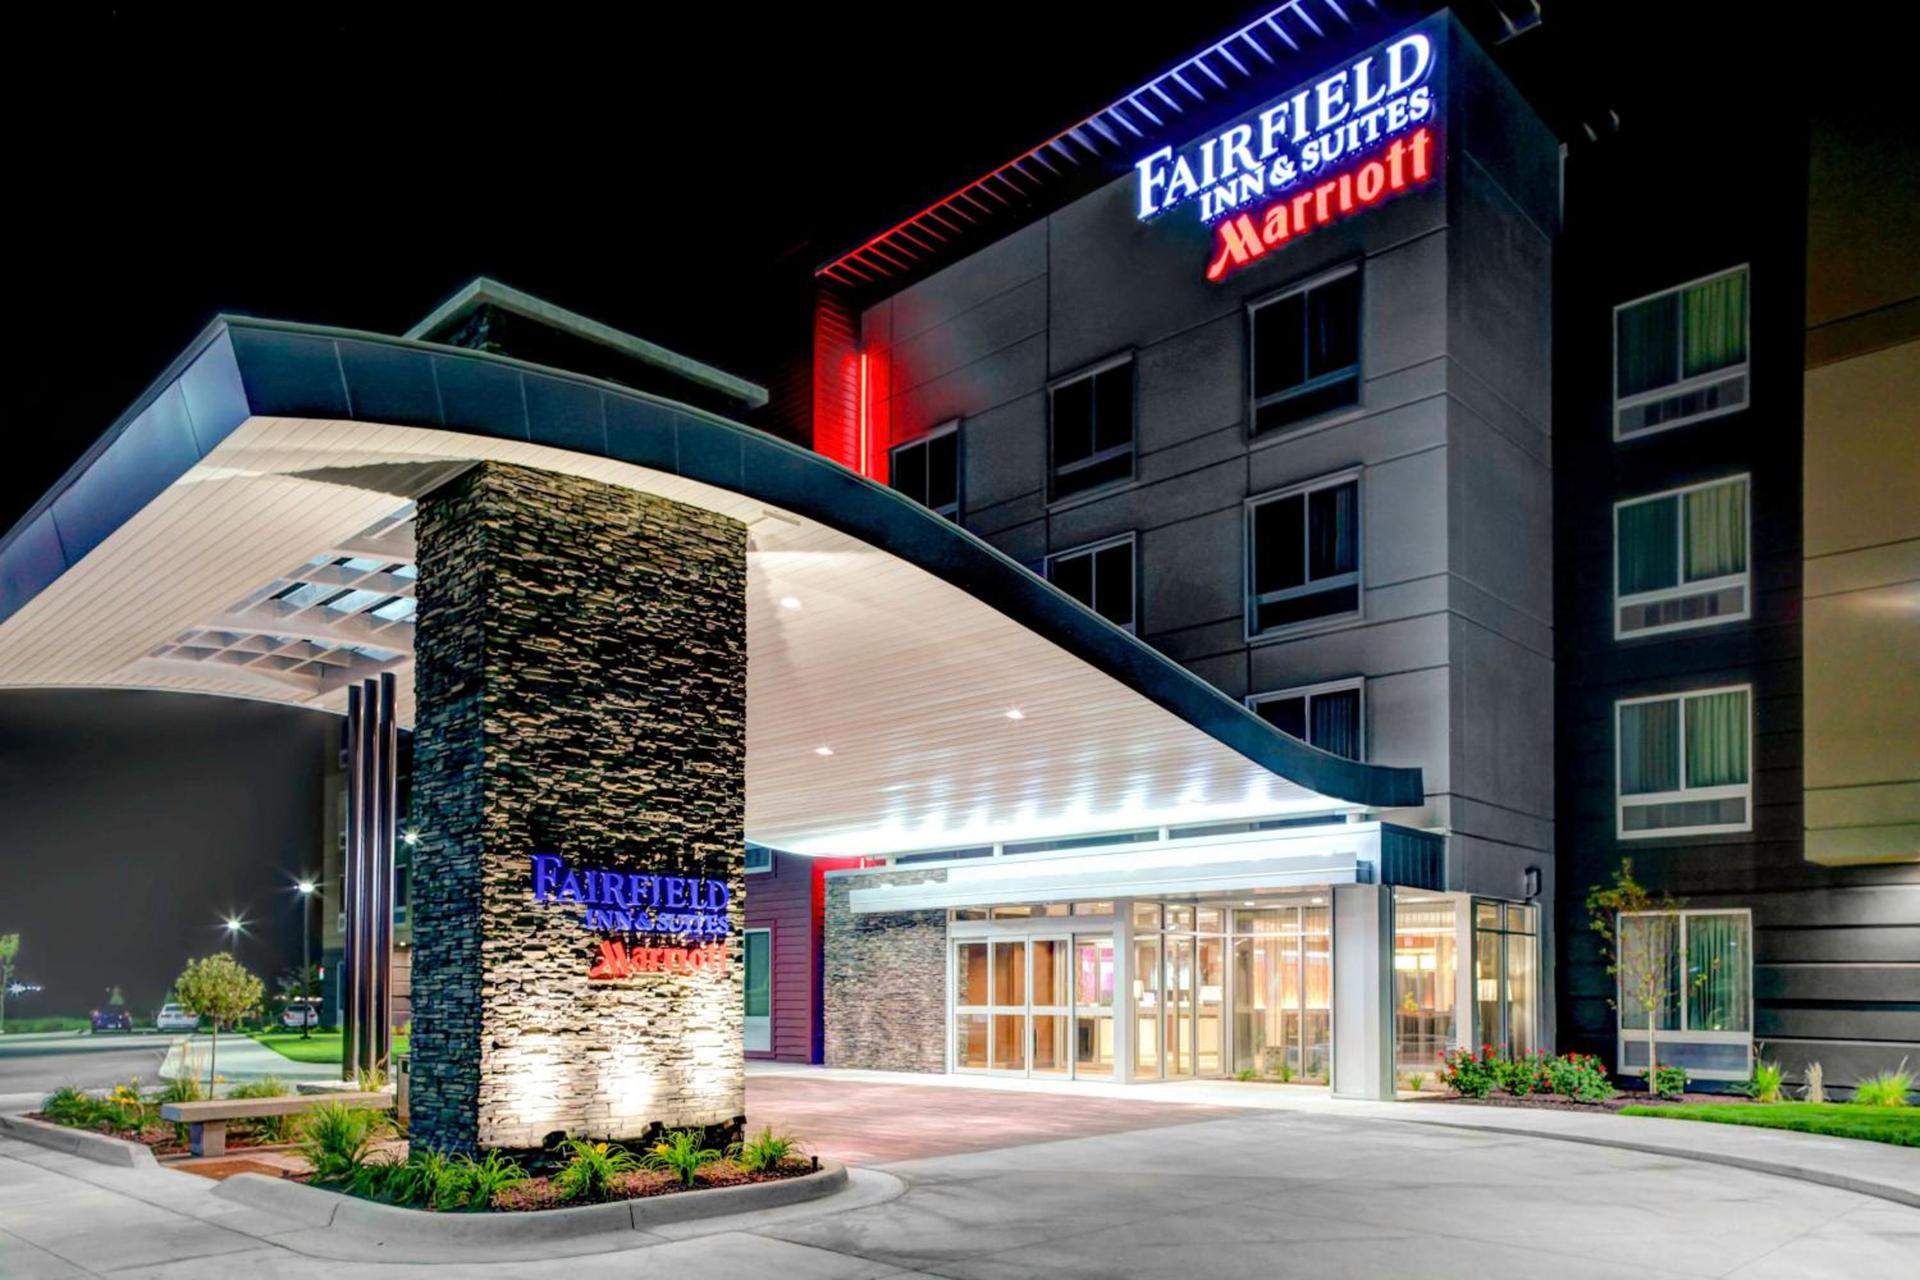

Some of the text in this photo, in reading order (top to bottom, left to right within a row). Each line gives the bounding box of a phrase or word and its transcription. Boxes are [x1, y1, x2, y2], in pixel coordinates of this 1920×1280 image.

[1135, 34, 1432, 221] FAIRFIELD
[1200, 86, 1431, 222] INN & SUITES
[1206, 128, 1430, 280] Marriott
[530, 854, 729, 909] FAIRFIELD
[584, 908, 729, 934] INN & SUITES
[588, 940, 727, 978] Marriott
